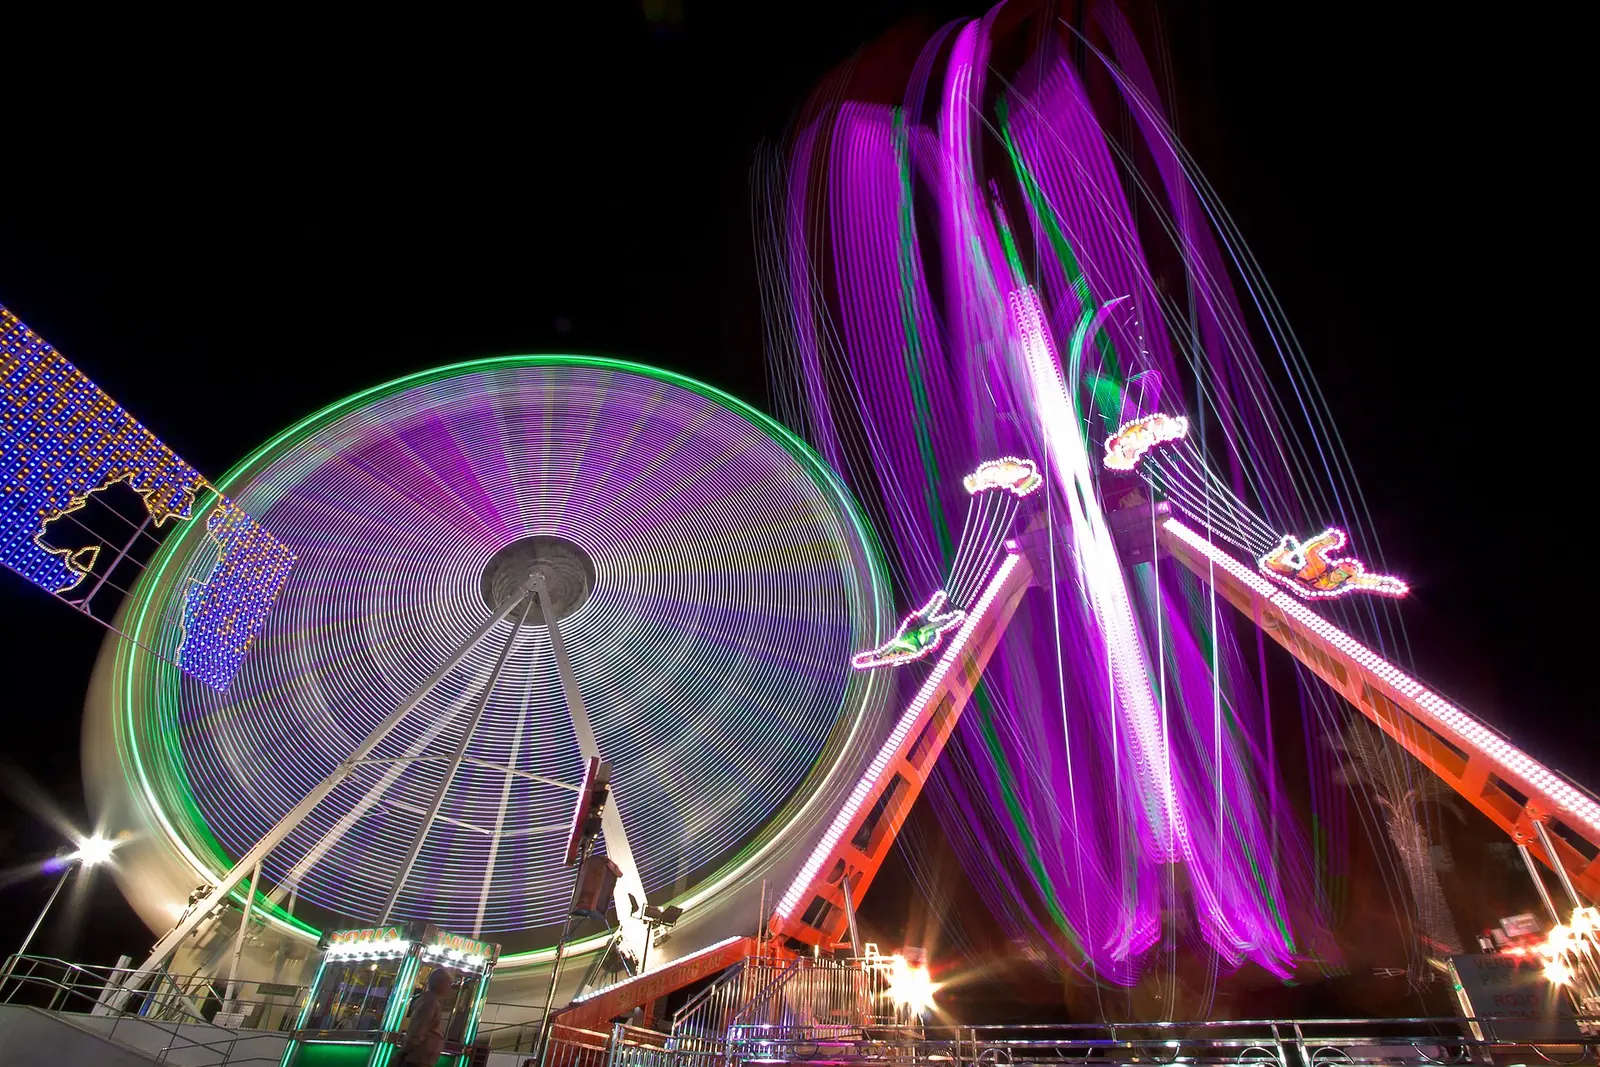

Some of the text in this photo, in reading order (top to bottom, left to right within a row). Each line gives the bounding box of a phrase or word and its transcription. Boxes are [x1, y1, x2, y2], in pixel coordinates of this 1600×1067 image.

[332, 927, 400, 944] NORIA
[437, 931, 492, 957] TAQUILLA
[616, 977, 666, 1010] SUPER
[670, 961, 700, 986] GIRO
[1493, 994, 1539, 1007] ROJO
